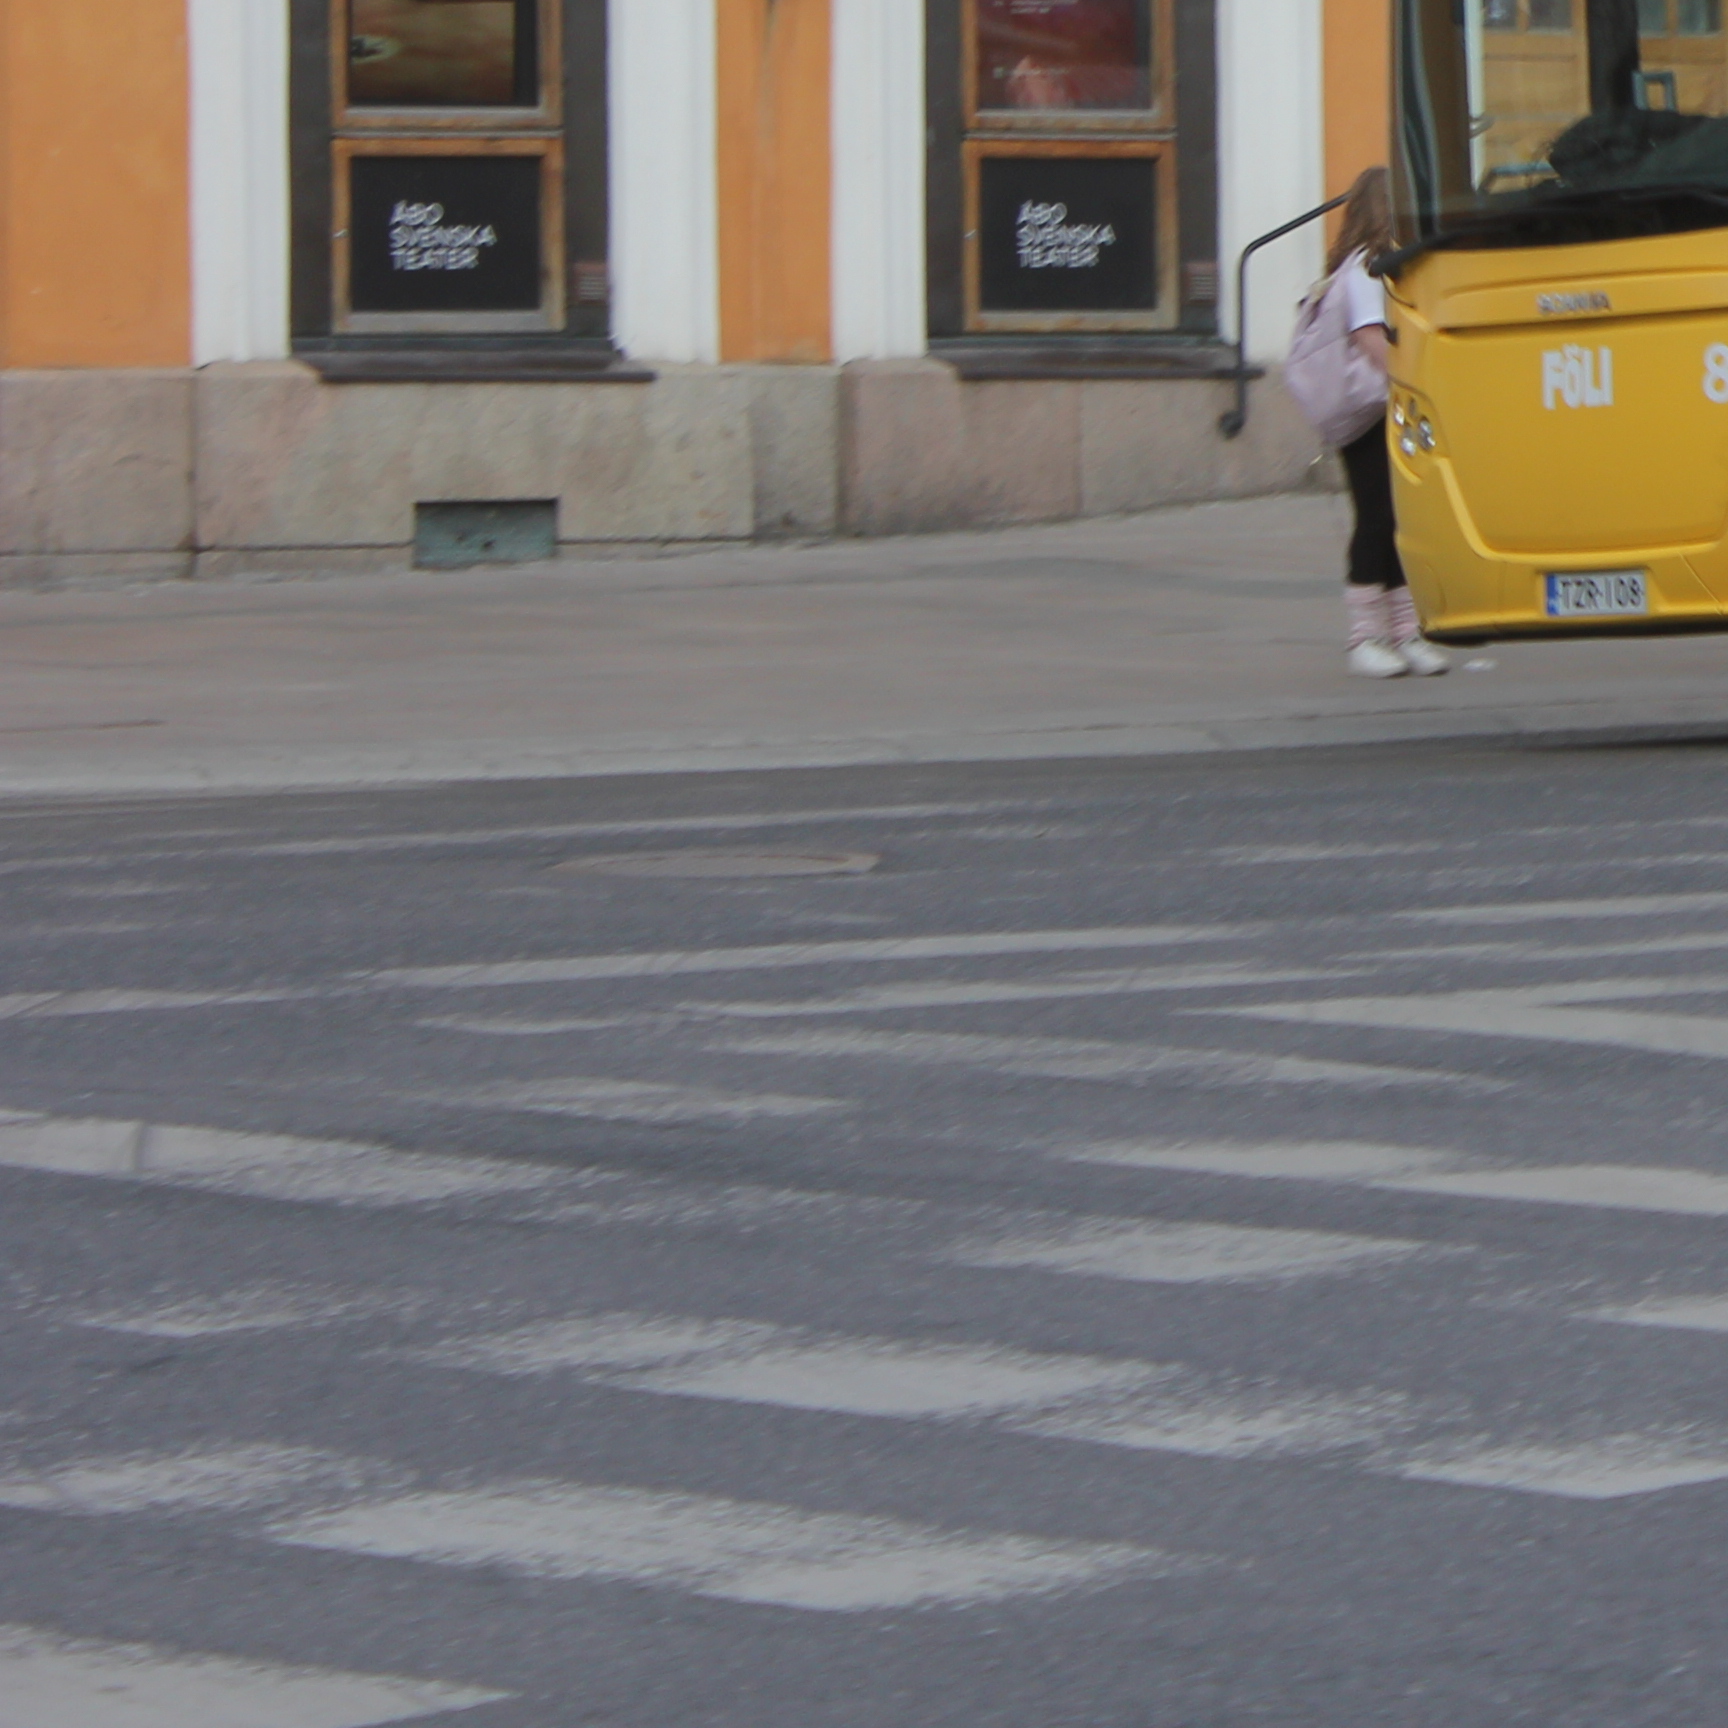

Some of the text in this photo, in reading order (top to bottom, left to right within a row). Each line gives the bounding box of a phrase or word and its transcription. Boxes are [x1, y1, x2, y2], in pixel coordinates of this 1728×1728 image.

[388, 224, 498, 248] SVENSKA
[1015, 223, 1117, 247] SVENSKA
[389, 246, 480, 270] TEATER
[1015, 244, 1100, 269] TEATER
[1541, 342, 1614, 410] FÖLI
